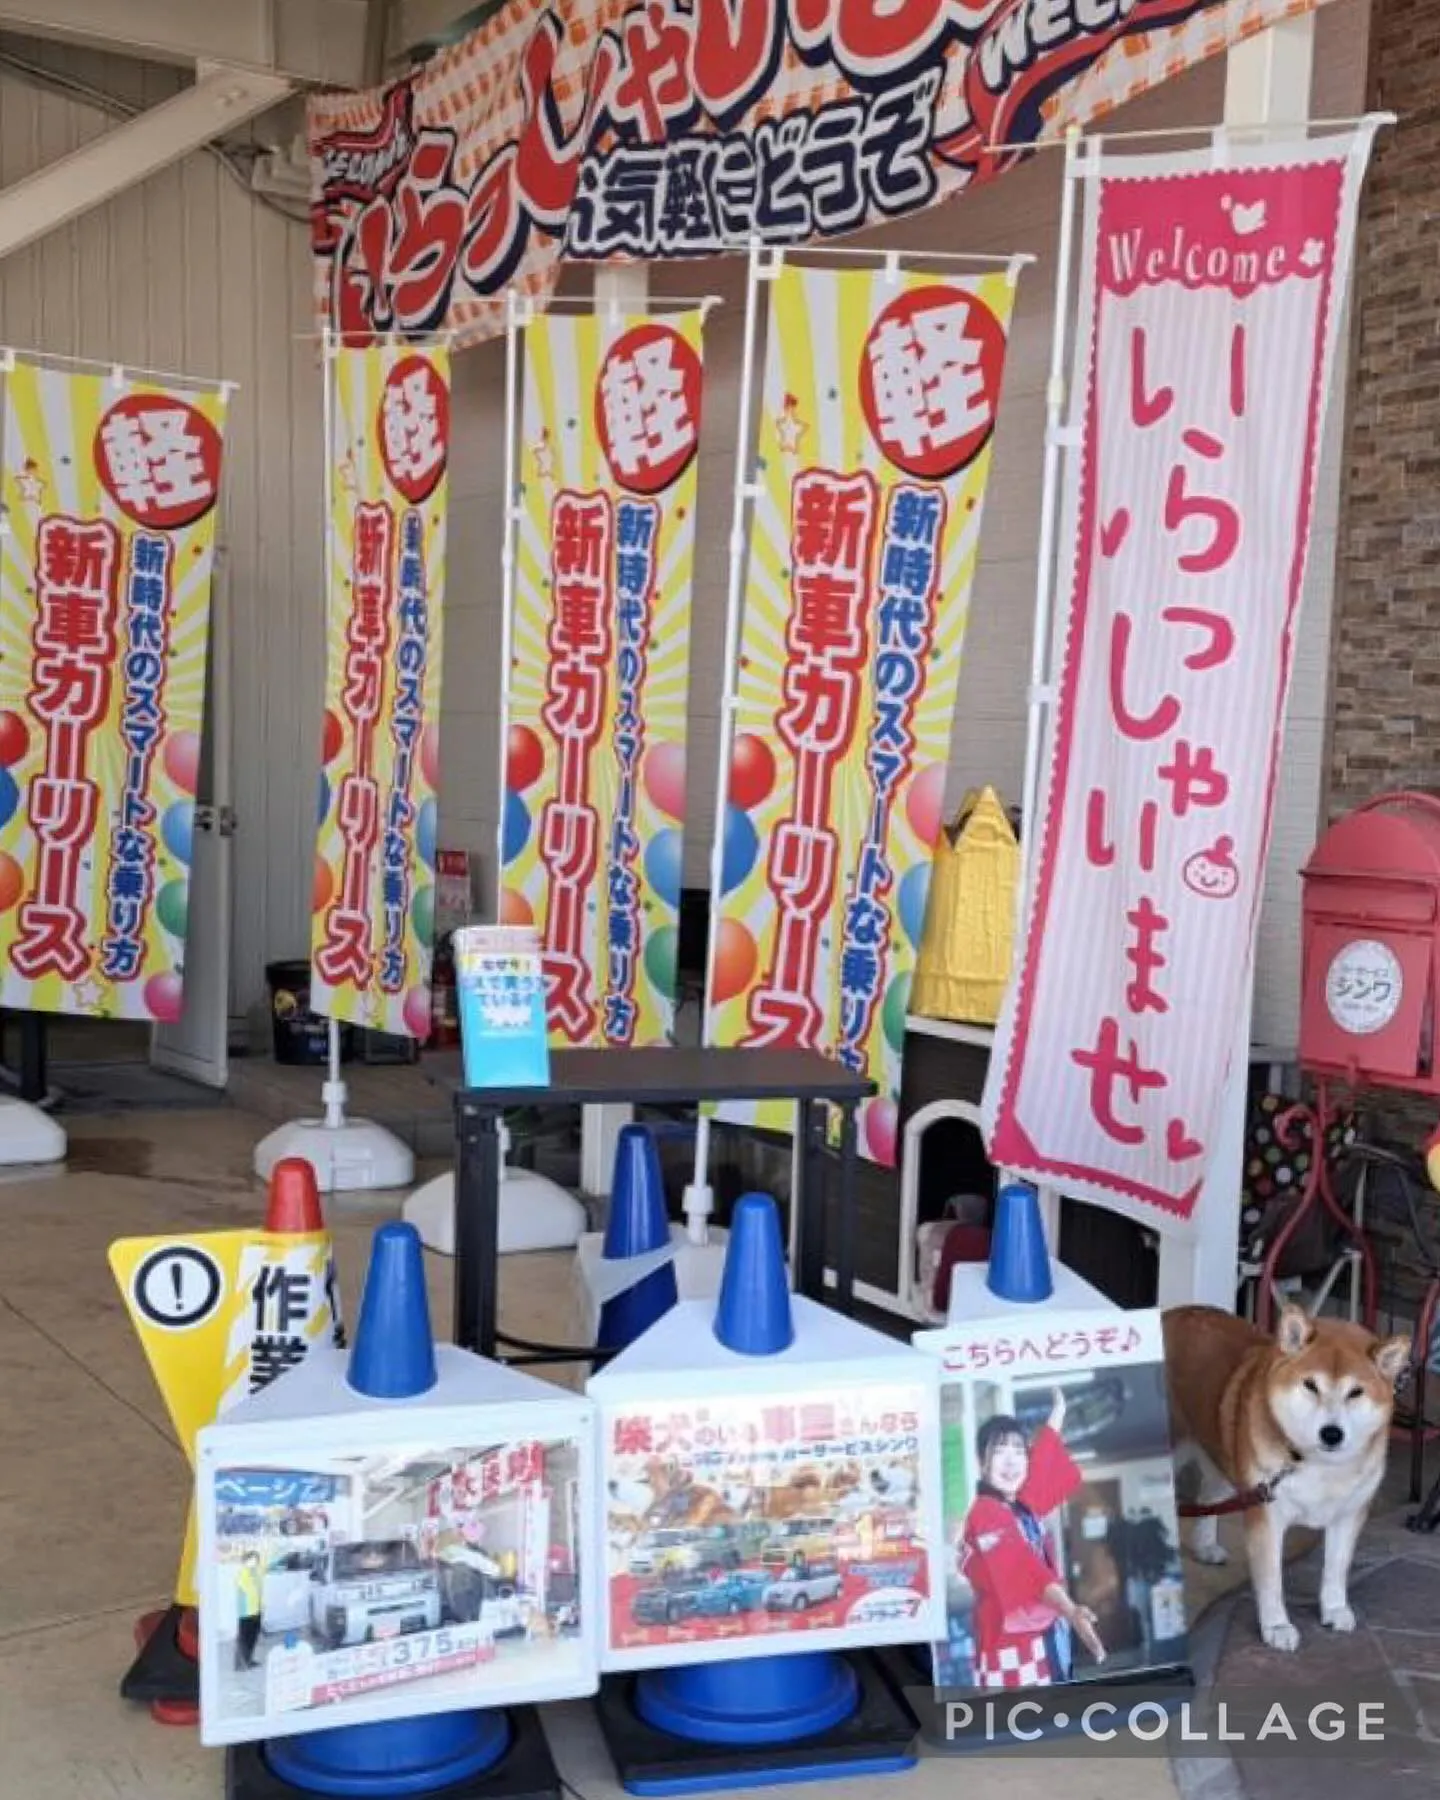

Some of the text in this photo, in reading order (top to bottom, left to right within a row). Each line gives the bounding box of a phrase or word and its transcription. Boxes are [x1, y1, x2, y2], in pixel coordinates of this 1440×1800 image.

[870, 302, 993, 458] 軽
[1107, 227, 1286, 284] Welcome
[101, 407, 213, 515] 軽
[382, 364, 445, 483] 軽
[601, 338, 696, 477] 軽
[18, 520, 113, 976] 新車カーリース
[103, 534, 168, 974] 新時代のスマートな乗り方
[322, 504, 389, 985] 新車カーリース
[541, 499, 606, 1035] 新車カーリース
[748, 480, 868, 1047] 新車カーリース
[1070, 322, 1246, 1145] いらっしゃいませ
[1334, 976, 1392, 1003] シンワ
